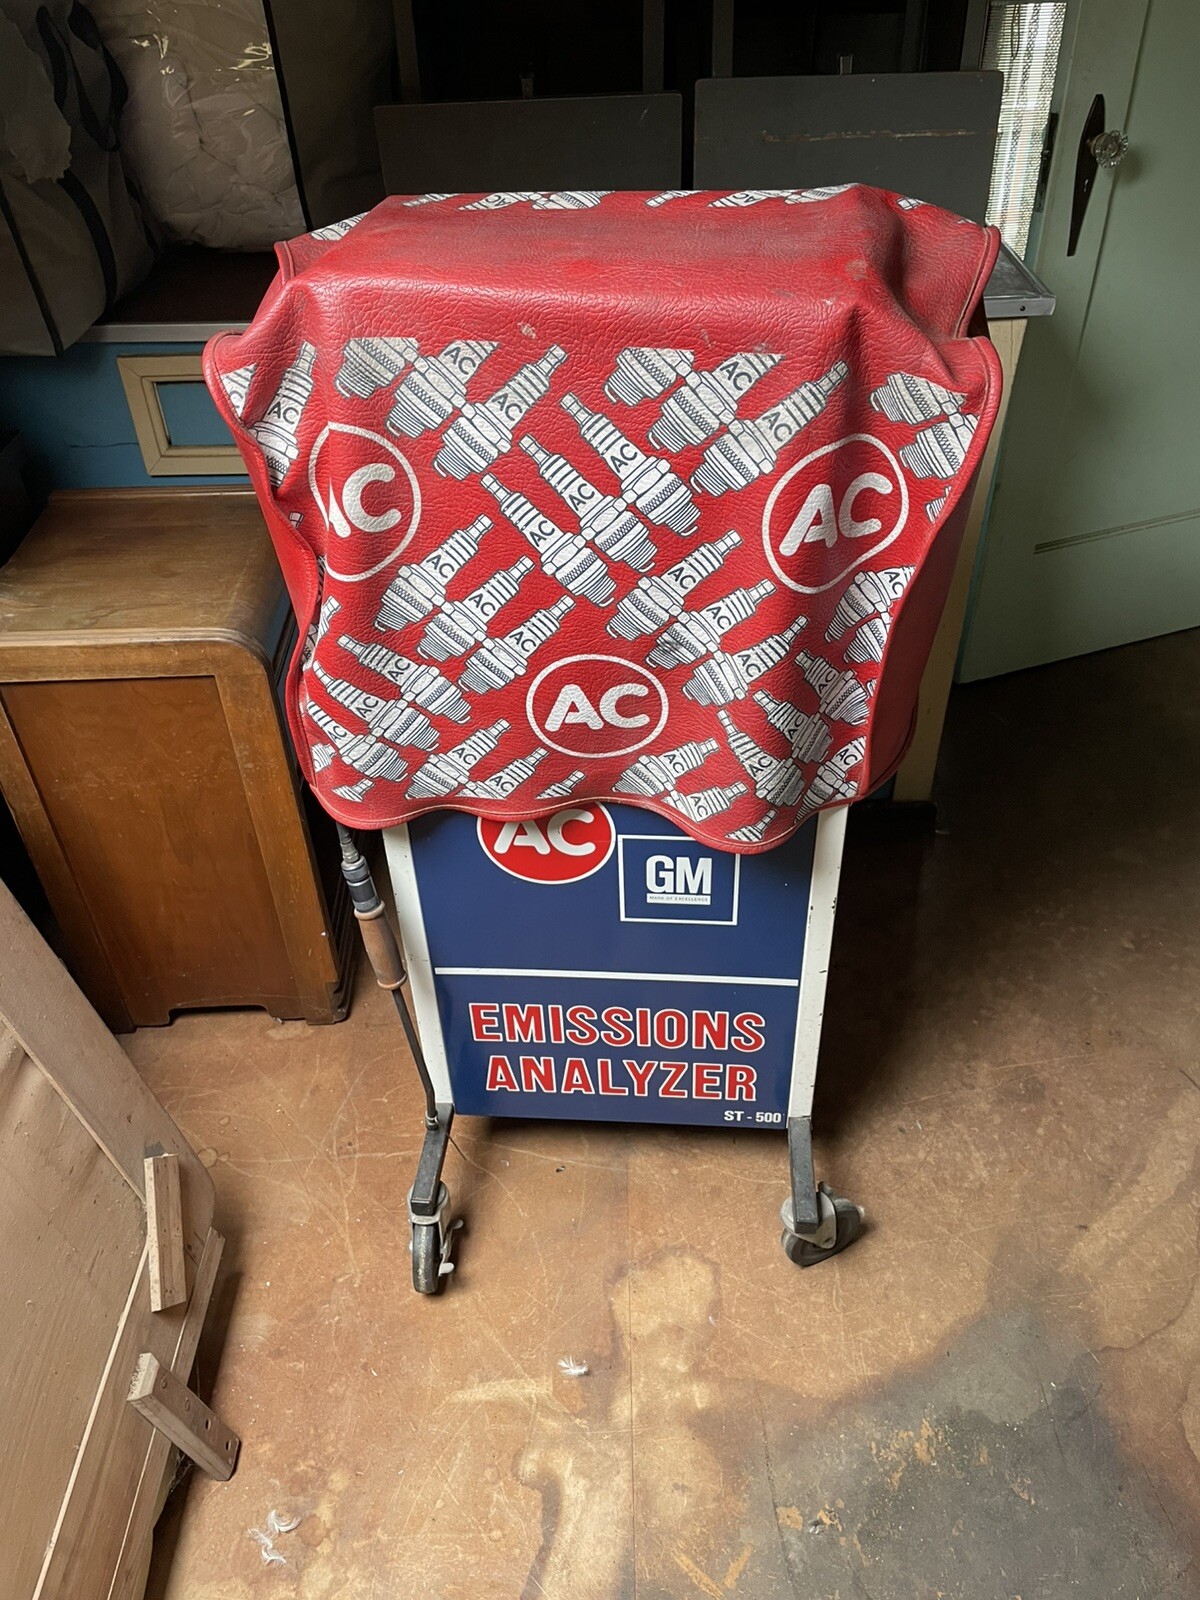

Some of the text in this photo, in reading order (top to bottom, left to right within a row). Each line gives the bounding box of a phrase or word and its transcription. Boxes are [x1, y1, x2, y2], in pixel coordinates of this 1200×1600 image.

[444, 345, 476, 375] AC
[720, 360, 752, 391] AC
[267, 401, 299, 425] AC
[492, 392, 523, 421] AC
[761, 411, 792, 442] AC
[610, 443, 638, 473] AC
[569, 483, 595, 511] AC
[779, 472, 893, 556] AC
[529, 519, 555, 547] AC
[426, 554, 455, 578] AC
[667, 567, 696, 590] AC
[884, 572, 904, 595] AC
[468, 593, 496, 617] AC
[706, 606, 731, 630] AC
[509, 630, 537, 652] AC
[390, 659, 411, 682] AC
[737, 653, 761, 678] AC
[818, 670, 836, 694] AC
[359, 695, 379, 718] AC
[545, 683, 650, 732] AC
[328, 725, 348, 745] AC
[788, 715, 805, 739] AC
[452, 746, 478, 765] AC
[664, 754, 685, 774] AC
[749, 757, 773, 777] AC
[836, 748, 858, 766] AC
[490, 775, 514, 793] AC
[691, 795, 710, 818] AC
[493, 809, 596, 856] AC
[646, 855, 712, 894] GM
[468, 1002, 766, 1053] EMISSIONS
[485, 1055, 758, 1102] ANALYZER
